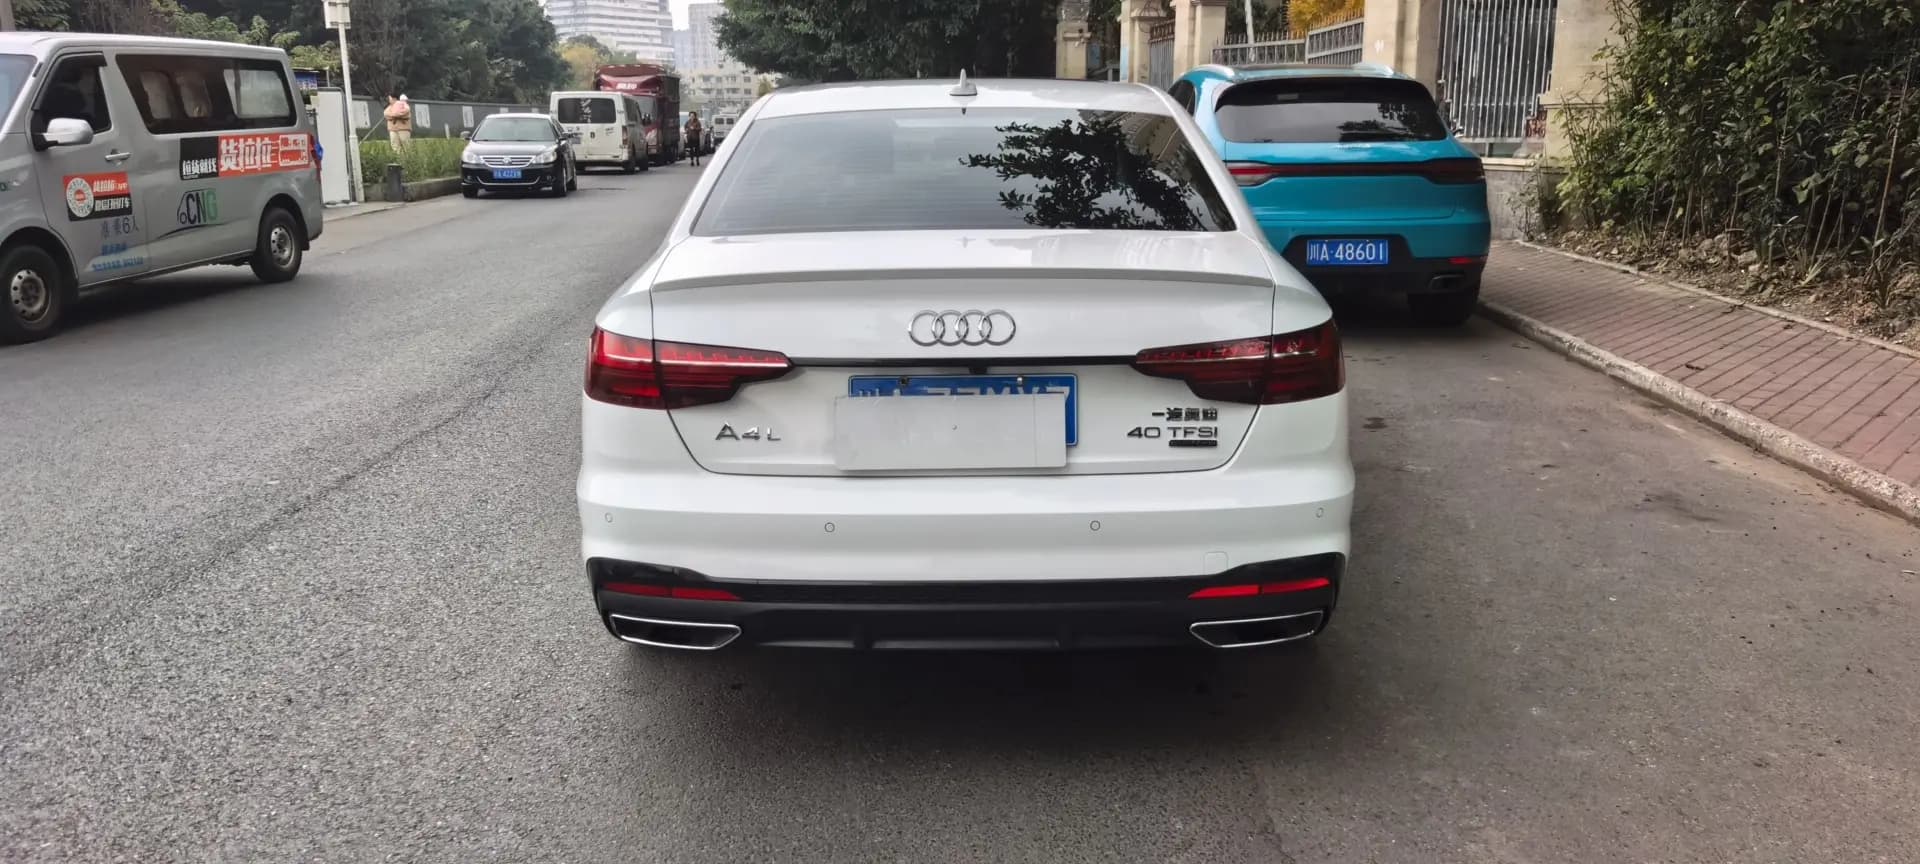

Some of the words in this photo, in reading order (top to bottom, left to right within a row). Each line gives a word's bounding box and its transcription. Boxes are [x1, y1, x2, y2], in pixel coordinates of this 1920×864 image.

[220, 136, 272, 172] 货拉拉
[186, 190, 218, 225] CNG
[1127, 426, 1161, 439] 40
[1167, 426, 1218, 439] TFSI
